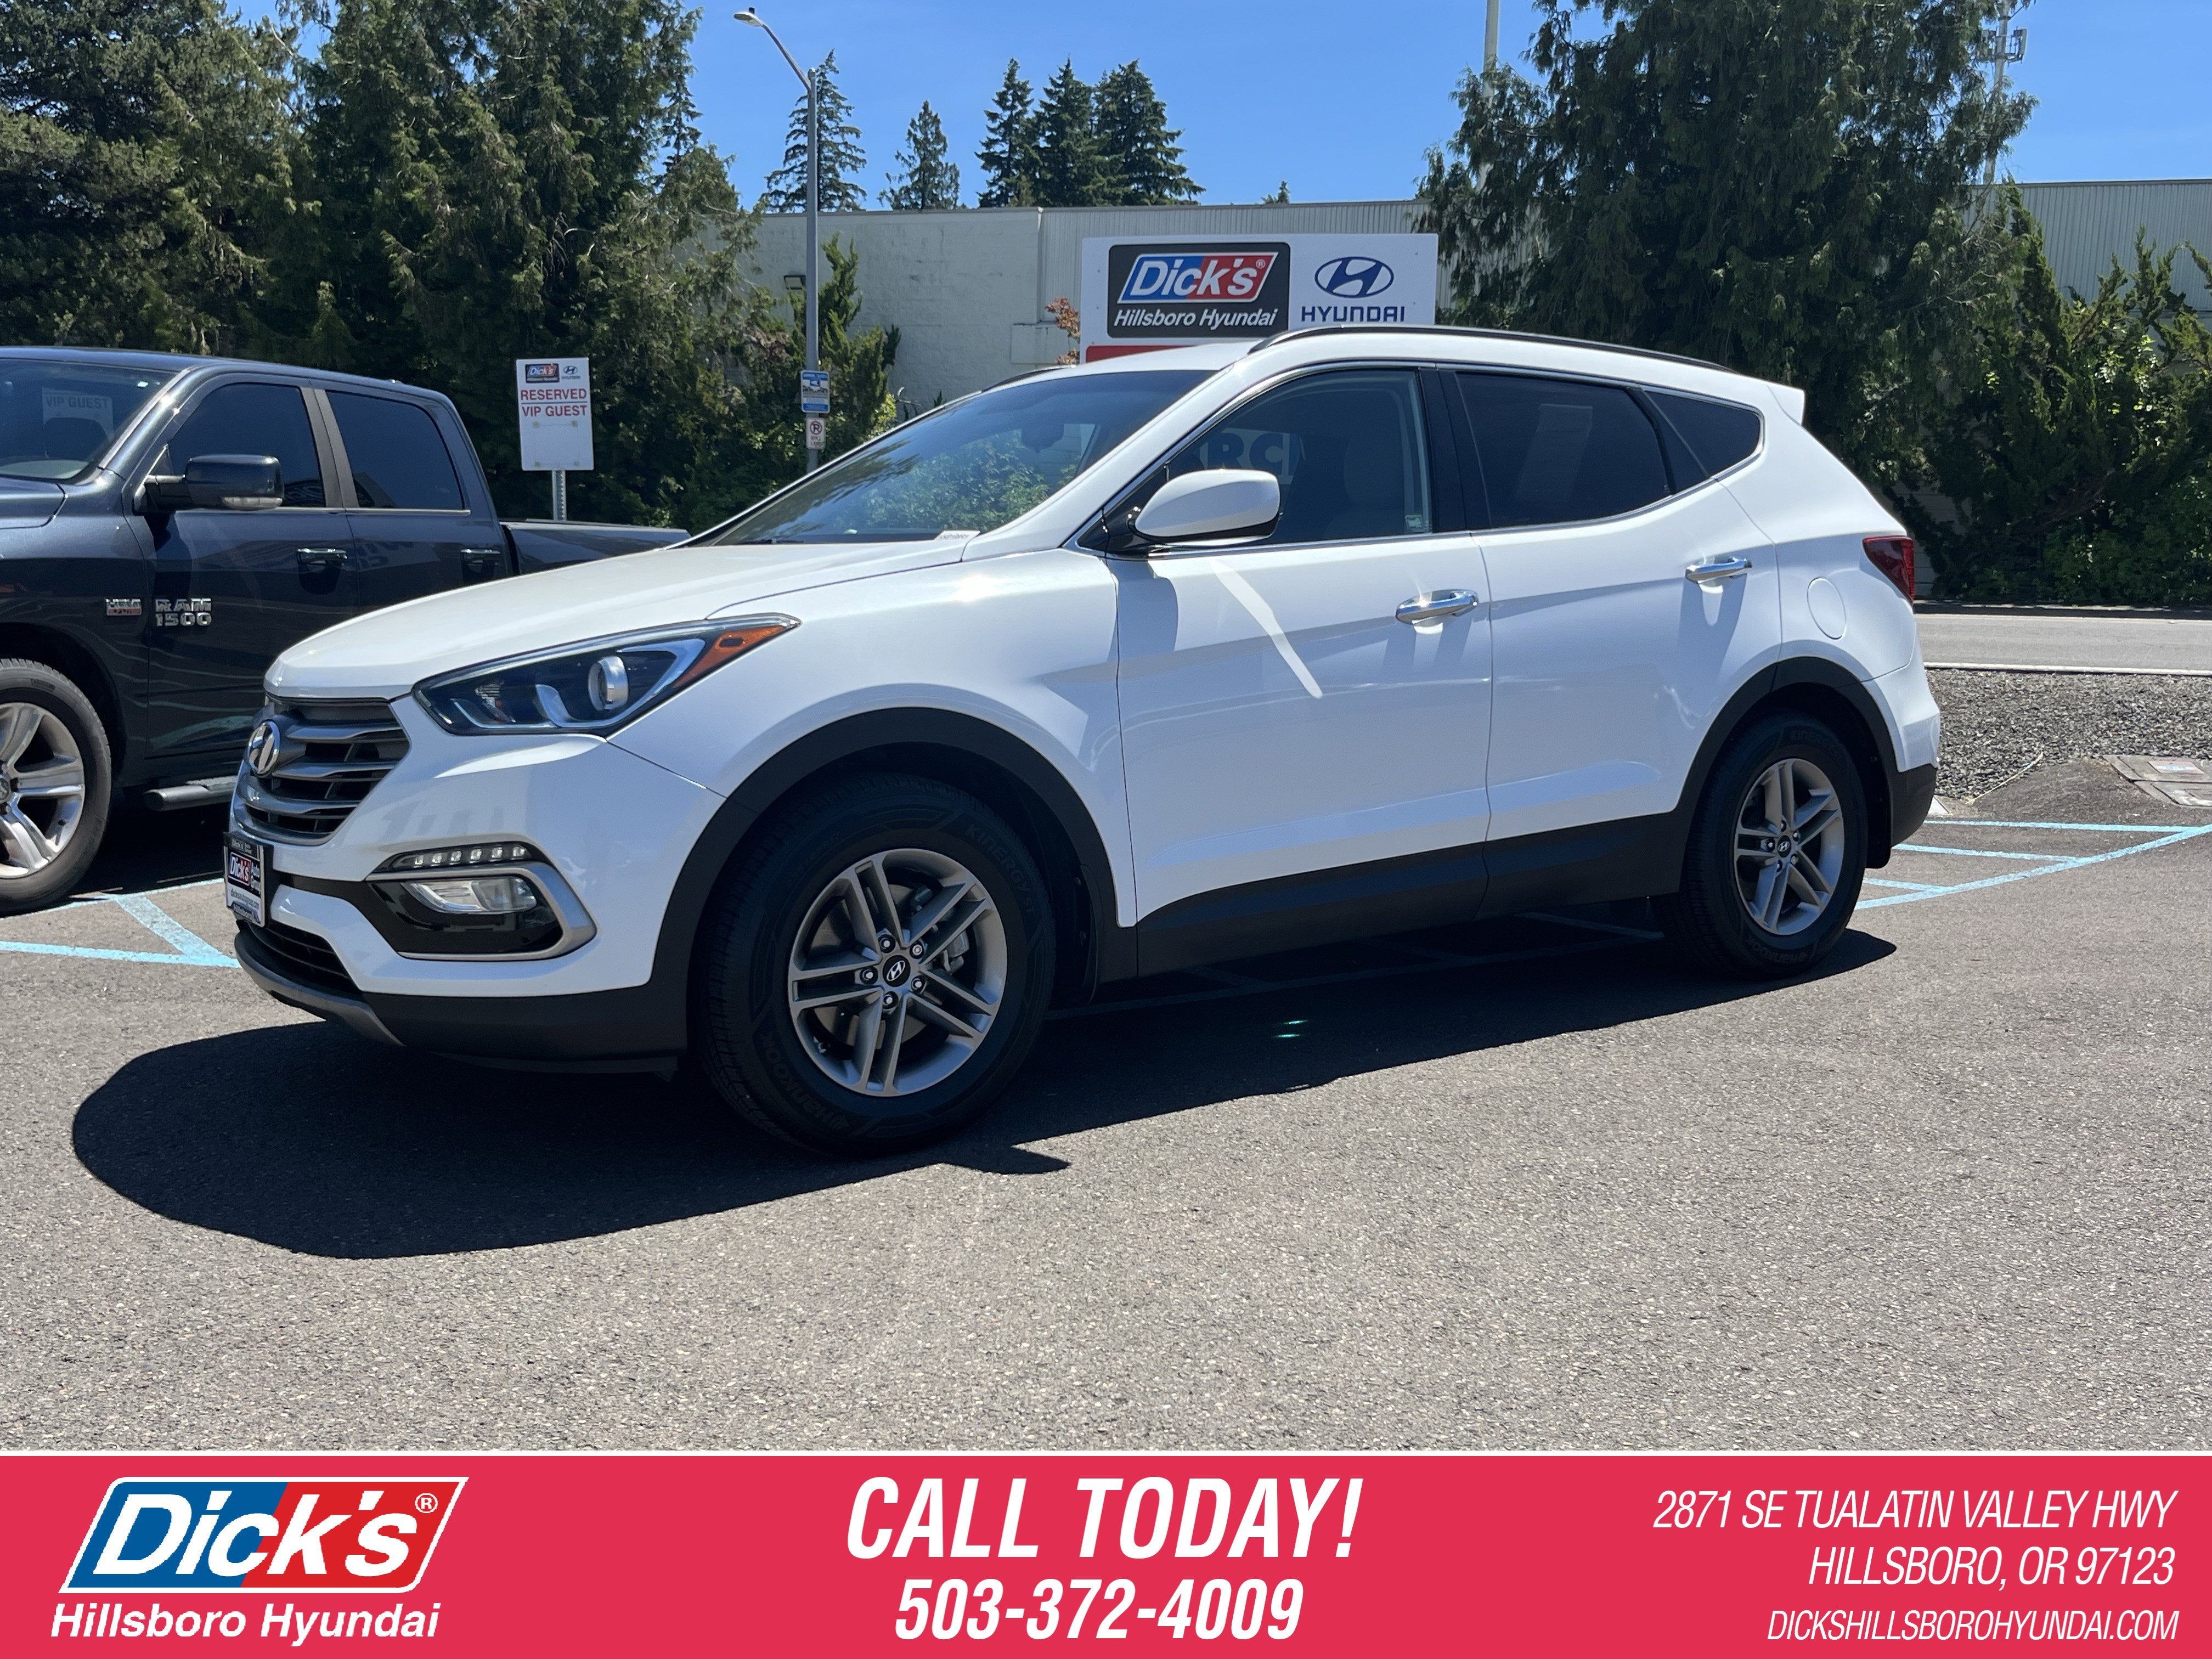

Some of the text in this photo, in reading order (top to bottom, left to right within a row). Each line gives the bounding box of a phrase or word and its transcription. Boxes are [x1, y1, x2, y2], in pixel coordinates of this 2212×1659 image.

[1129, 257, 1256, 297] Dick's
[1114, 308, 1278, 330] Hillsboro Hyundai
[1301, 306, 1405, 323] HYUNDAI
[521, 388, 587, 400] RESERVED
[45, 396, 108, 409] VIP GUEST
[522, 405, 587, 417] VIP GUEST
[155, 598, 212, 612] RAM
[156, 612, 212, 626] 1500
